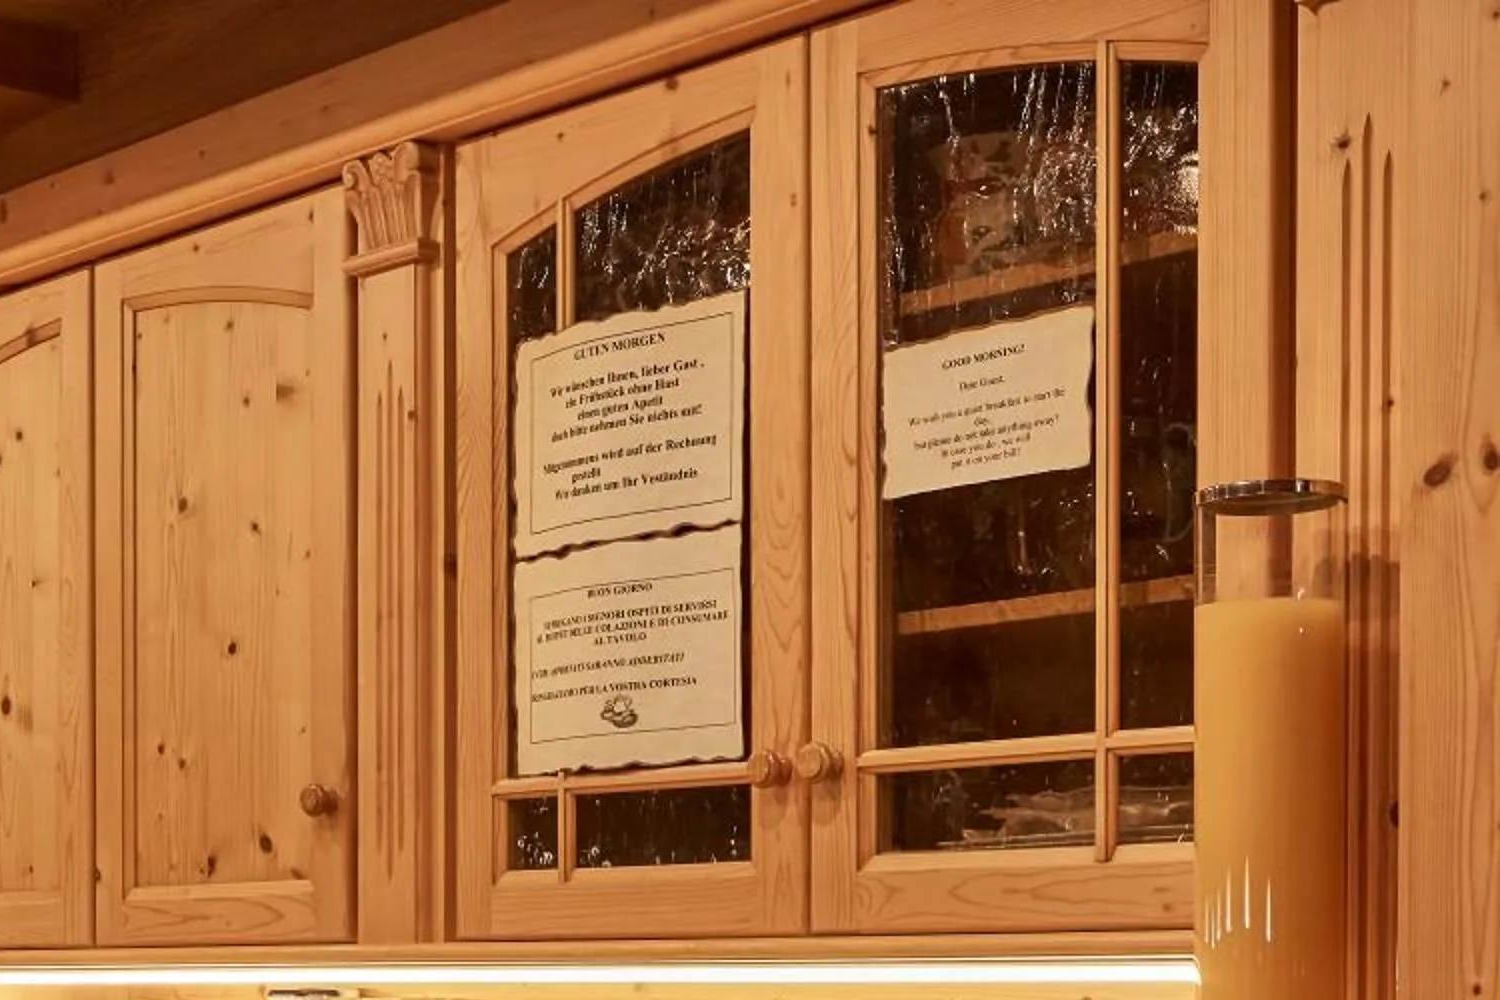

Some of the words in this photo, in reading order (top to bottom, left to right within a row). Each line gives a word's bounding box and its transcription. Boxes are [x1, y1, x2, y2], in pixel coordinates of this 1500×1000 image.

[573, 346, 609, 361] GUTEN
[611, 333, 665, 354] MORGEN
[942, 356, 971, 370] GOOD
[629, 414, 644, 425] Sie
